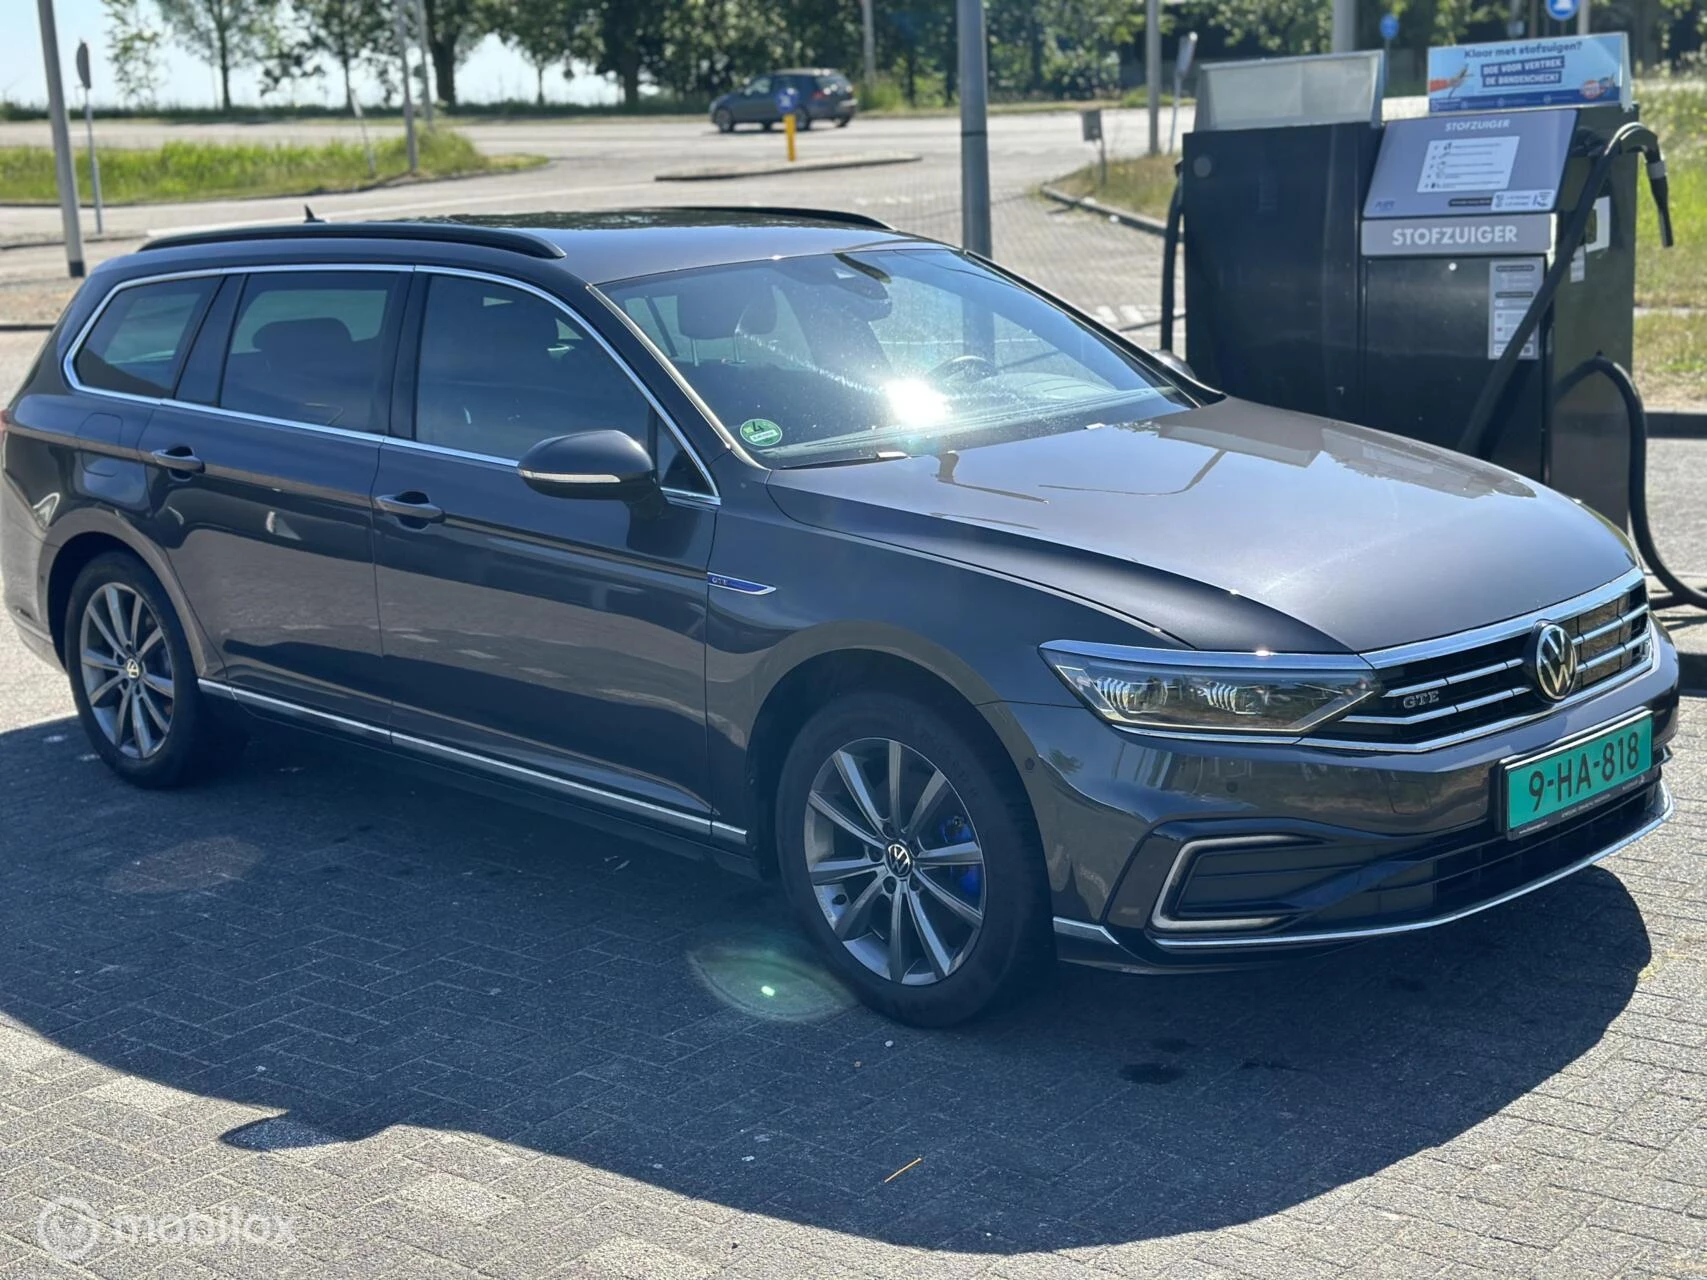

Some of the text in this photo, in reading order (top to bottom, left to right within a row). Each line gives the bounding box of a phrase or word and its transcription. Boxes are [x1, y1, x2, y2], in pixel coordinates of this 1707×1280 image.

[1495, 45, 1517, 57] met
[1519, 41, 1583, 55] stofzuigen?
[1501, 61, 1523, 72] VOOR
[1524, 58, 1562, 71] VERTREK
[1445, 119, 1511, 132] STOFZUIGER
[1392, 225, 1518, 246] STOFZUIGER
[1403, 690, 1440, 709] GTE
[1528, 732, 1639, 813] 9-HA-818
